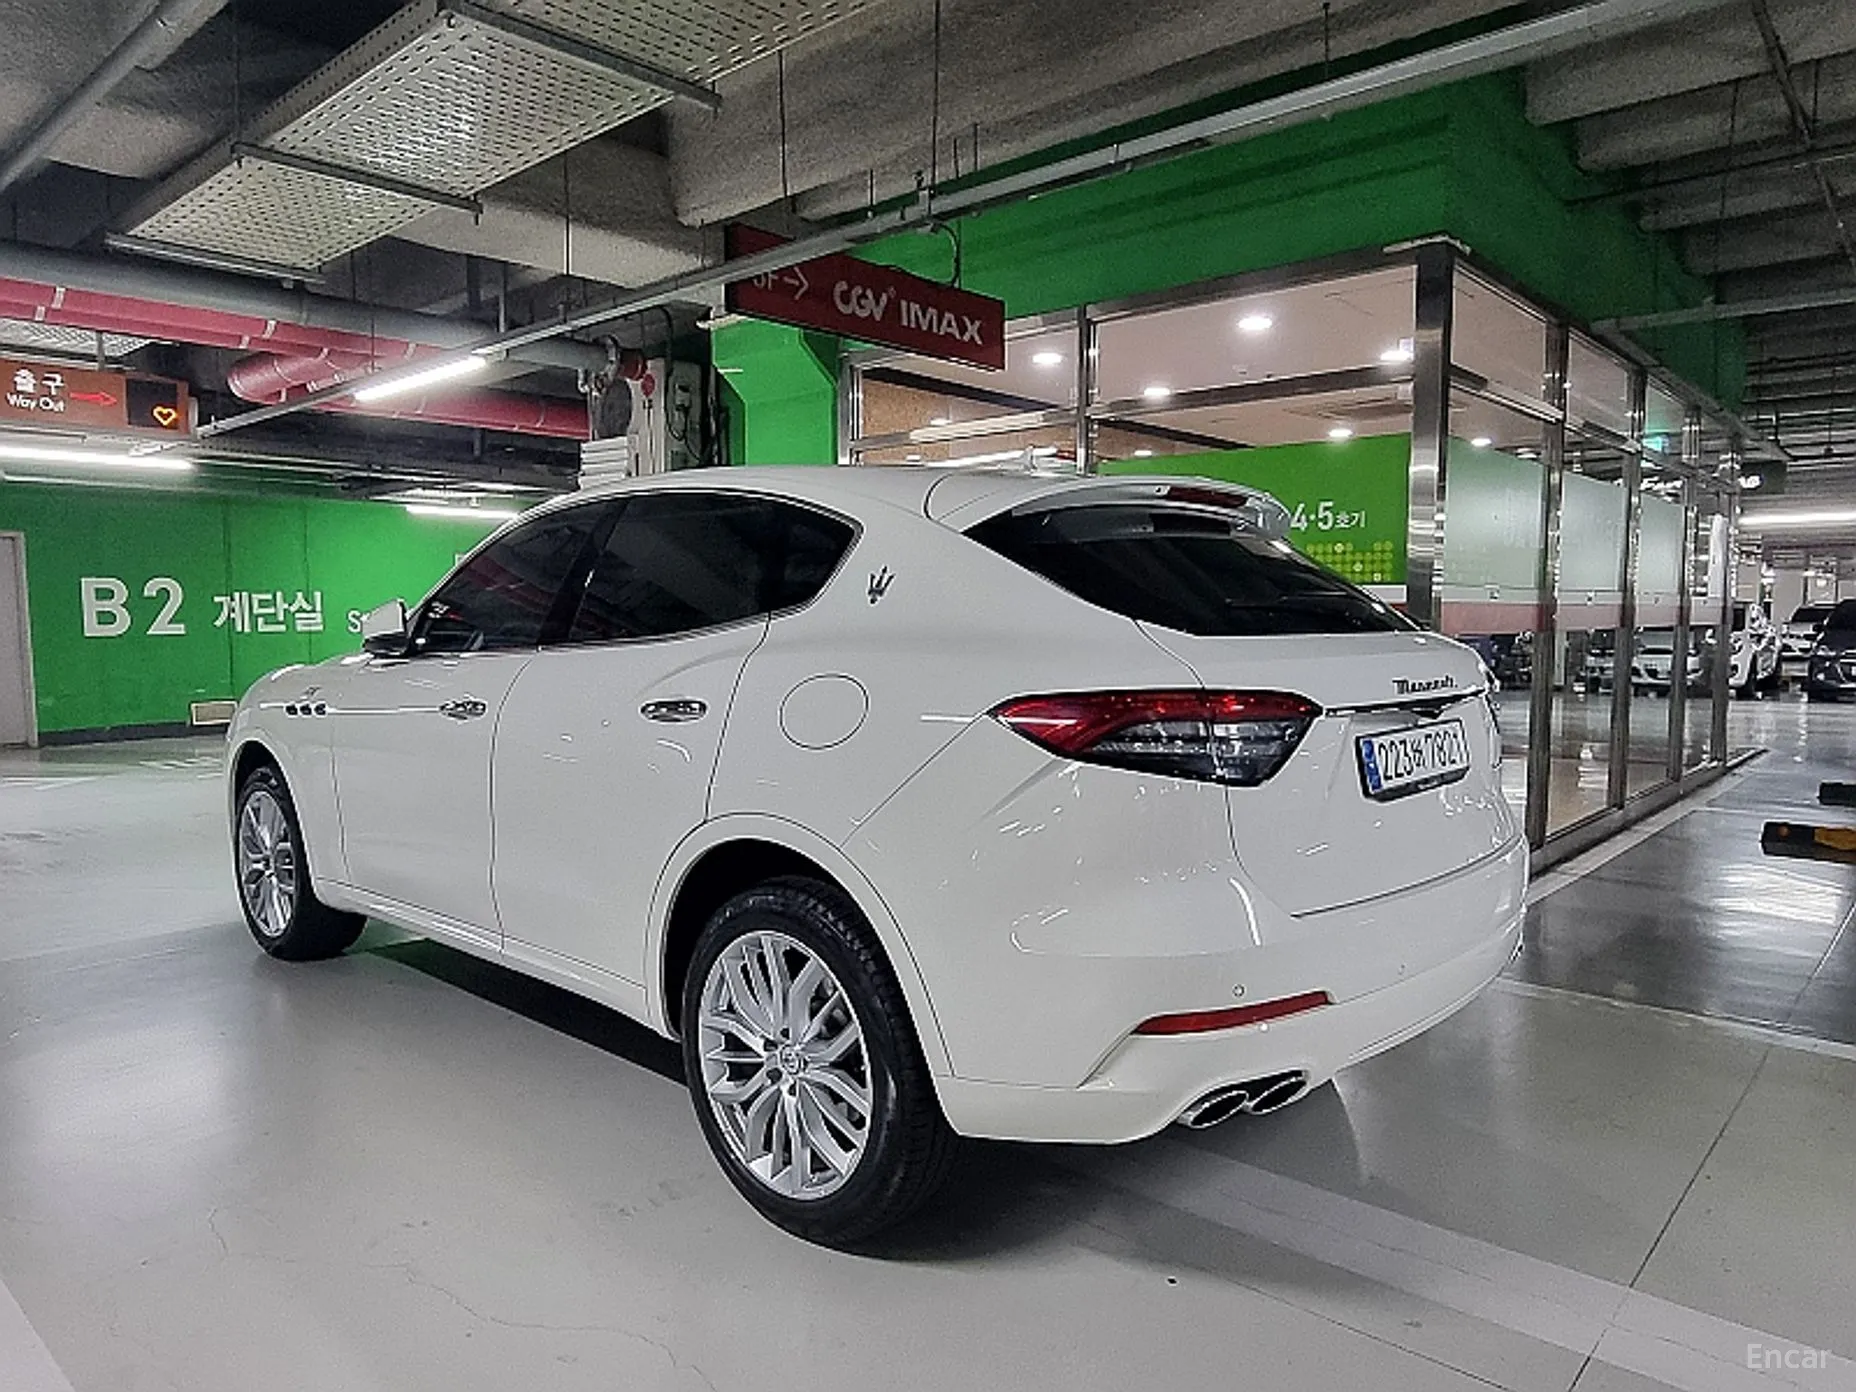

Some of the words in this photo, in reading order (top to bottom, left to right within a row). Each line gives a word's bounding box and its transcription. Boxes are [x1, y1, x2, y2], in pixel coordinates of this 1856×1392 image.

[833, 281, 889, 322] CGV
[900, 300, 983, 345] IMAX
[6, 392, 38, 411] Way
[39, 396, 65, 412] Out
[213, 591, 324, 633] 계단실
